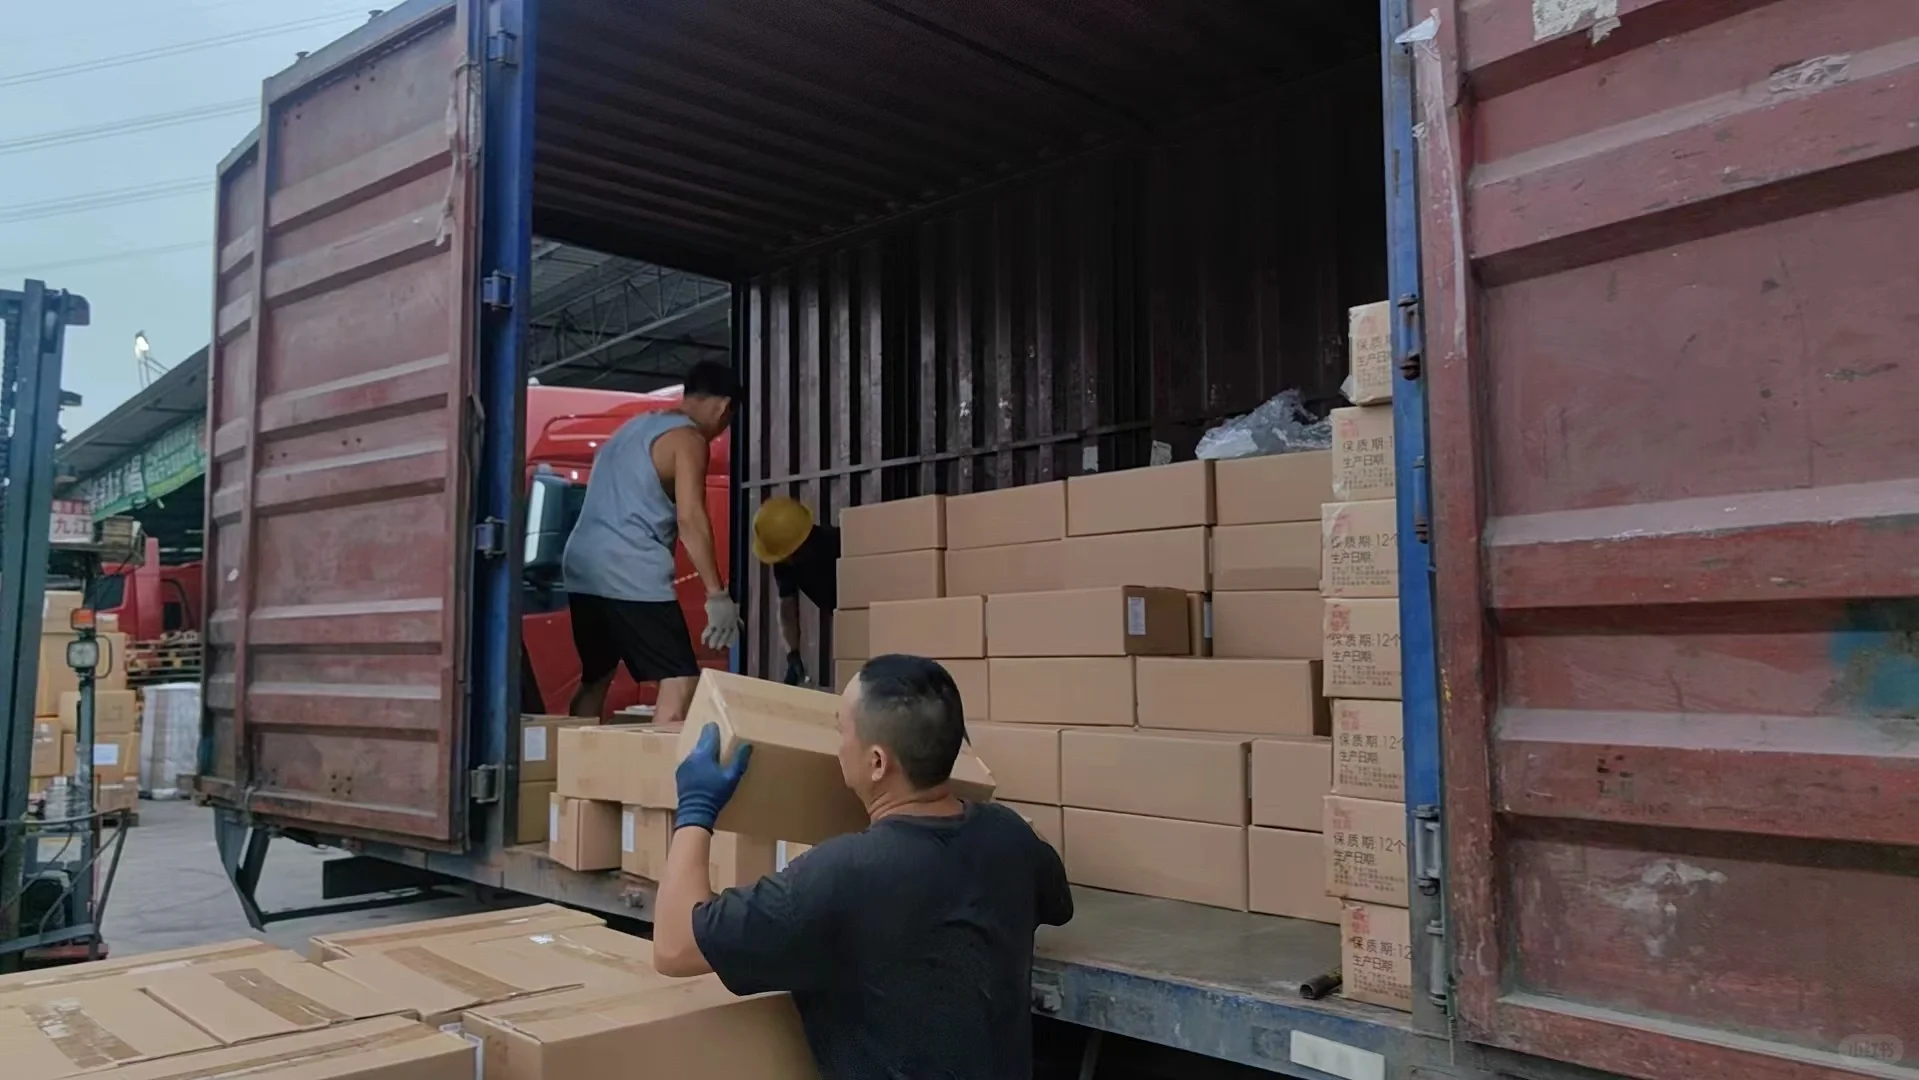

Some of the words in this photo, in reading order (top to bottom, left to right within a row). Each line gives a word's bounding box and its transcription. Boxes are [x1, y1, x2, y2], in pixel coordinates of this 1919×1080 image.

[1356, 335, 1391, 351] 保质
[1356, 351, 1391, 367] 生产日
